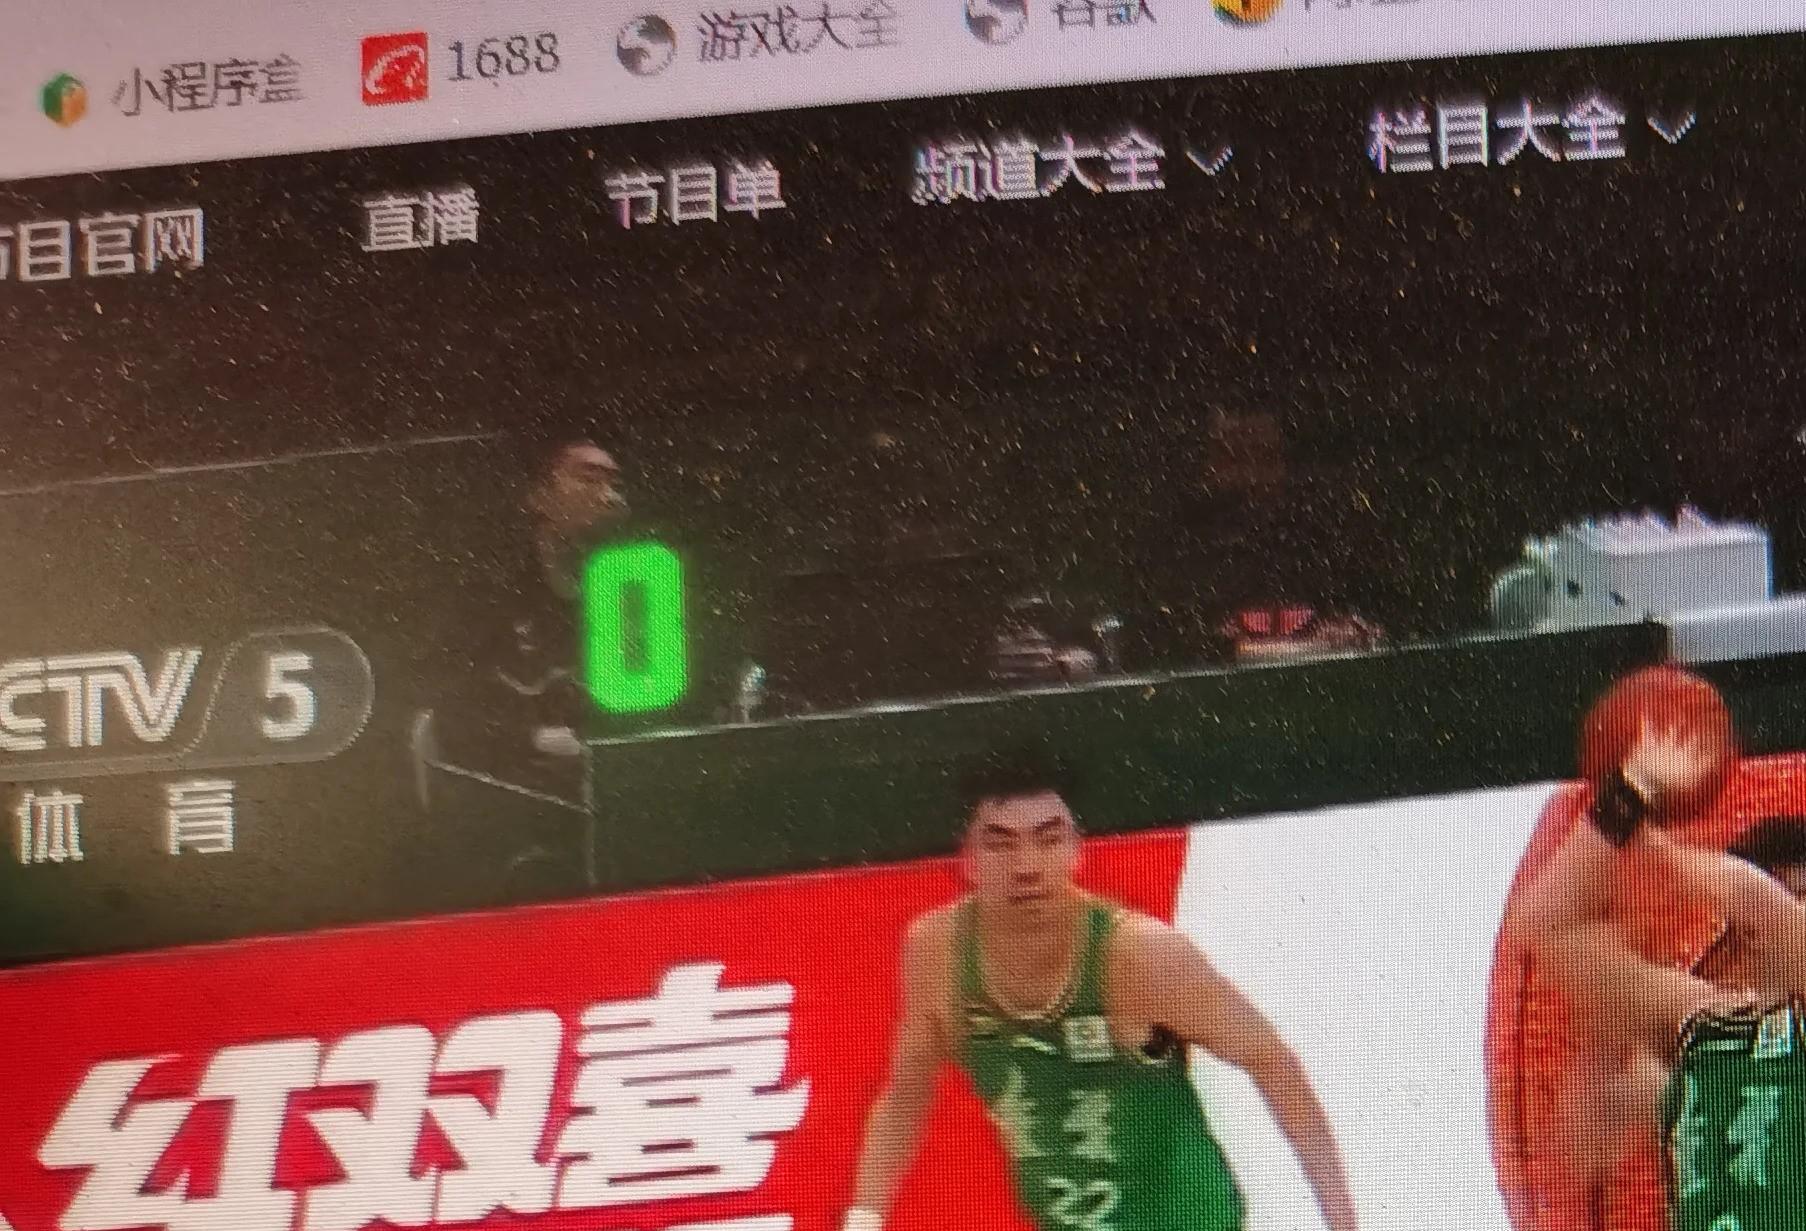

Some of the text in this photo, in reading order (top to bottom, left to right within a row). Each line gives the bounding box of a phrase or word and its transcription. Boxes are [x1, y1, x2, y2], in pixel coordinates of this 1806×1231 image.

[447, 33, 560, 82] 1688
[696, 2, 902, 64] 游戏大全
[113, 55, 302, 118] 小程序盒
[912, 131, 1167, 205] 频道大全
[1368, 97, 1626, 173] 栏目大全
[362, 185, 481, 252] 直播
[606, 160, 786, 229] 节目单
[0, 207, 204, 282] 目官网
[583, 538, 690, 714] 0
[260, 653, 317, 740] 5
[15, 780, 236, 864] 体育
